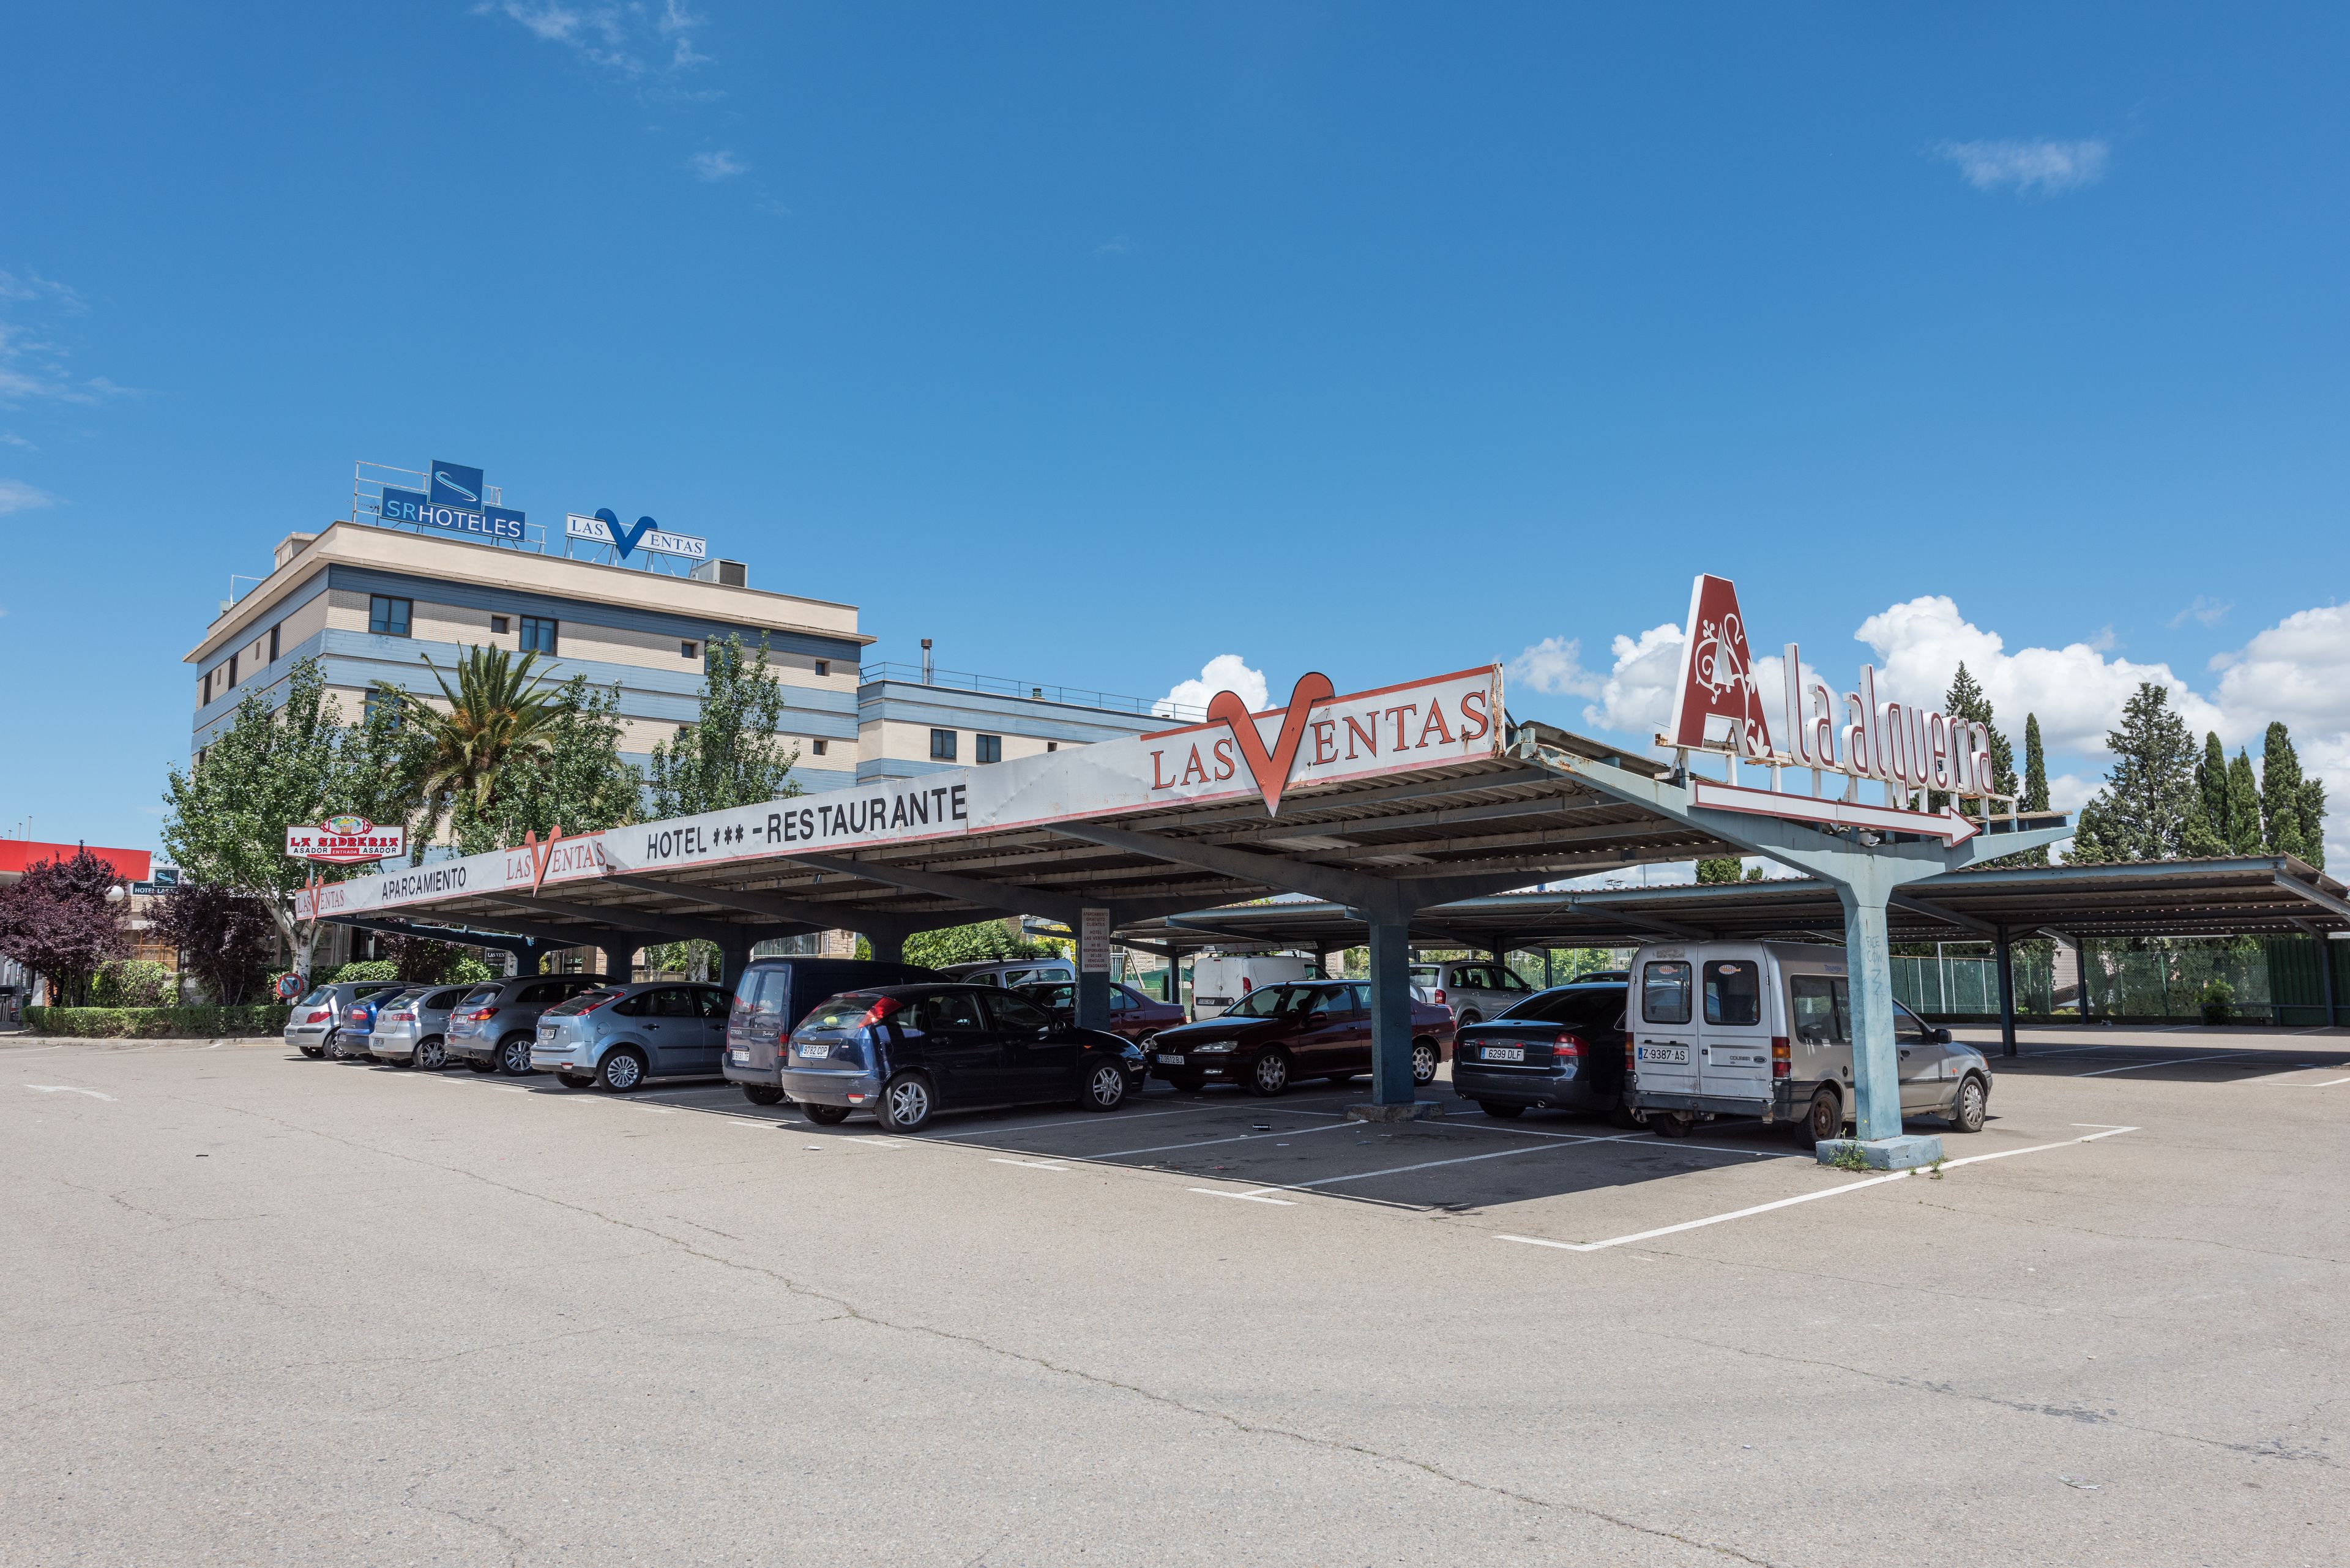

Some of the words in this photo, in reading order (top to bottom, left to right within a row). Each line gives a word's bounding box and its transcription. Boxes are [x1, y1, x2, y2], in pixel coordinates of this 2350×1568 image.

[571, 519, 603, 536] LAS
[594, 508, 703, 559] VENTAS
[1151, 737, 1235, 791] LAS
[1207, 671, 1489, 818] VENTAS
[290, 837, 311, 847] LA
[318, 837, 398, 847] SIDRERIA
[647, 826, 707, 860] HOTEL
[507, 854, 531, 880] LAS
[524, 825, 606, 898] VENTAS
[297, 895, 311, 913] LAS
[305, 875, 344, 925] VENTAS
[382, 867, 466, 901] APARCAMIENTO
[804, 1046, 816, 1055] 9782
[817, 1047, 827, 1055] CDP
[1489, 1049, 1505, 1058] 6299
[1508, 1050, 1521, 1059] DLF
